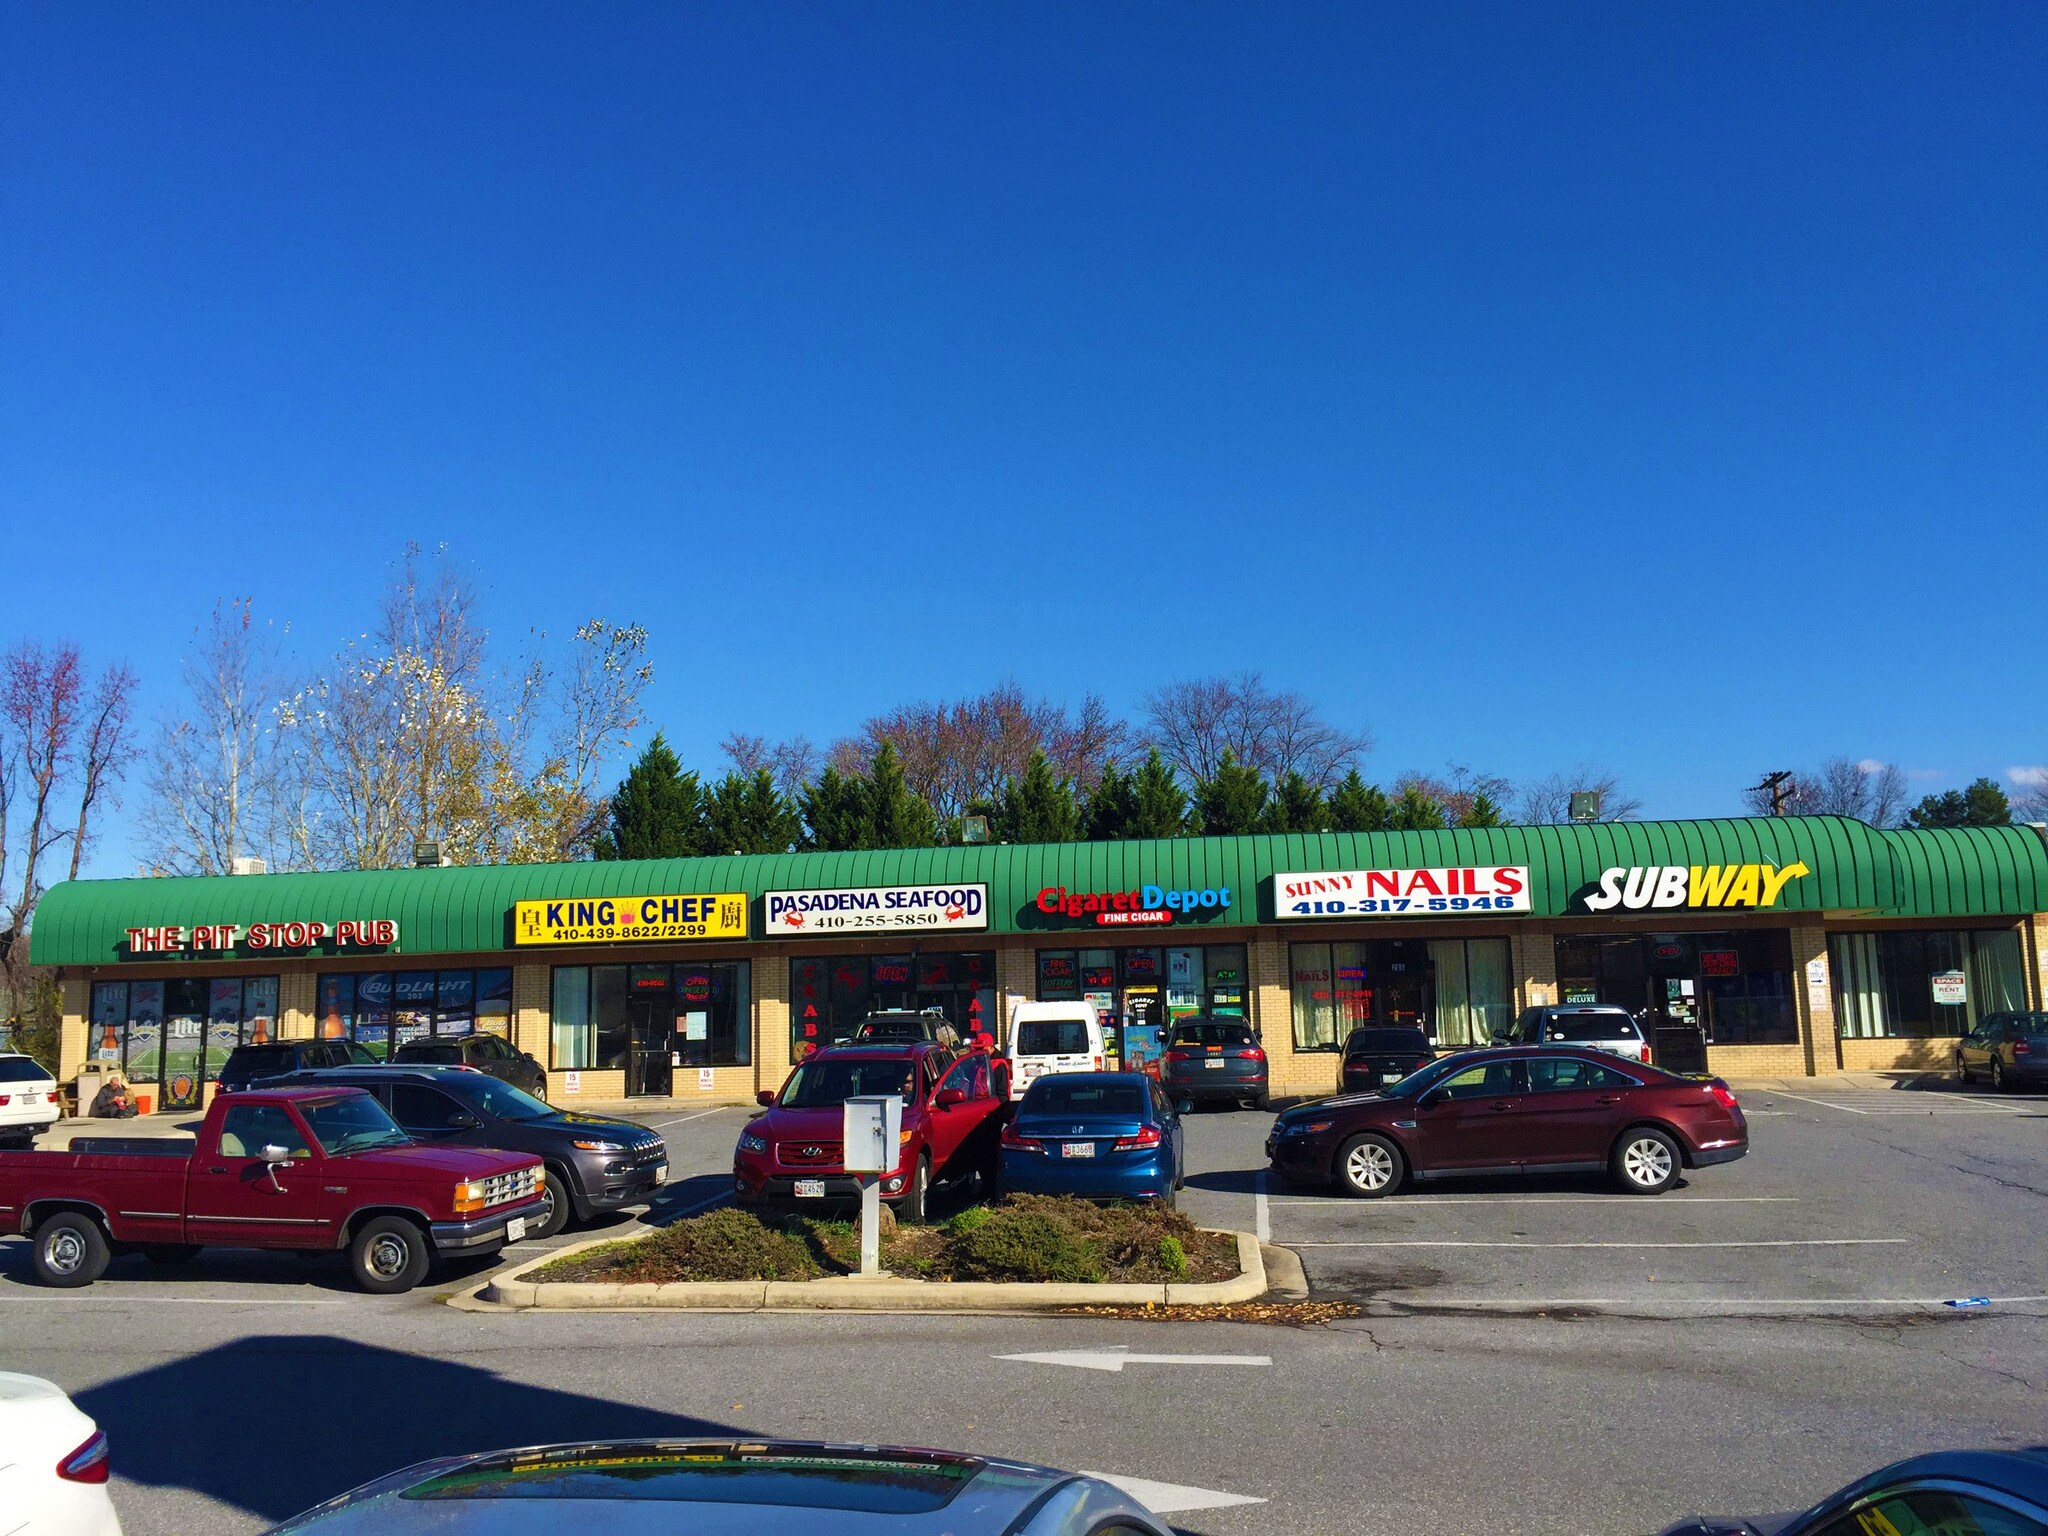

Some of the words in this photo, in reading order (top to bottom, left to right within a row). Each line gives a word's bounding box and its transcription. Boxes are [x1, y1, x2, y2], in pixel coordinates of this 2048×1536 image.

[1286, 875, 1354, 898] SUNNY
[1366, 868, 1522, 897] NAILS
[1584, 862, 1810, 912] SUBWAY
[547, 901, 615, 927] KING
[641, 897, 716, 924] CHEF
[771, 893, 880, 922] PASADENA
[885, 889, 981, 917] SEAFOOD
[1292, 896, 1514, 914] 410-317-5946
[815, 913, 938, 927] 410-255-5850
[1104, 913, 1128, 922] FINE
[1131, 912, 1163, 922] CIGAR
[125, 926, 184, 952] THE
[193, 925, 240, 950] PIT
[248, 922, 328, 948] STOP
[337, 920, 398, 945] PUB
[553, 925, 707, 940] 410-439-8622/2299
[1129, 960, 1154, 968] OPEN
[875, 966, 908, 981] OPEN
[1336, 970, 1364, 978] OPEN
[686, 978, 708, 986] OPEN
[1044, 979, 1073, 987] LOTTERY
[174, 1020, 201, 1038] Lite
